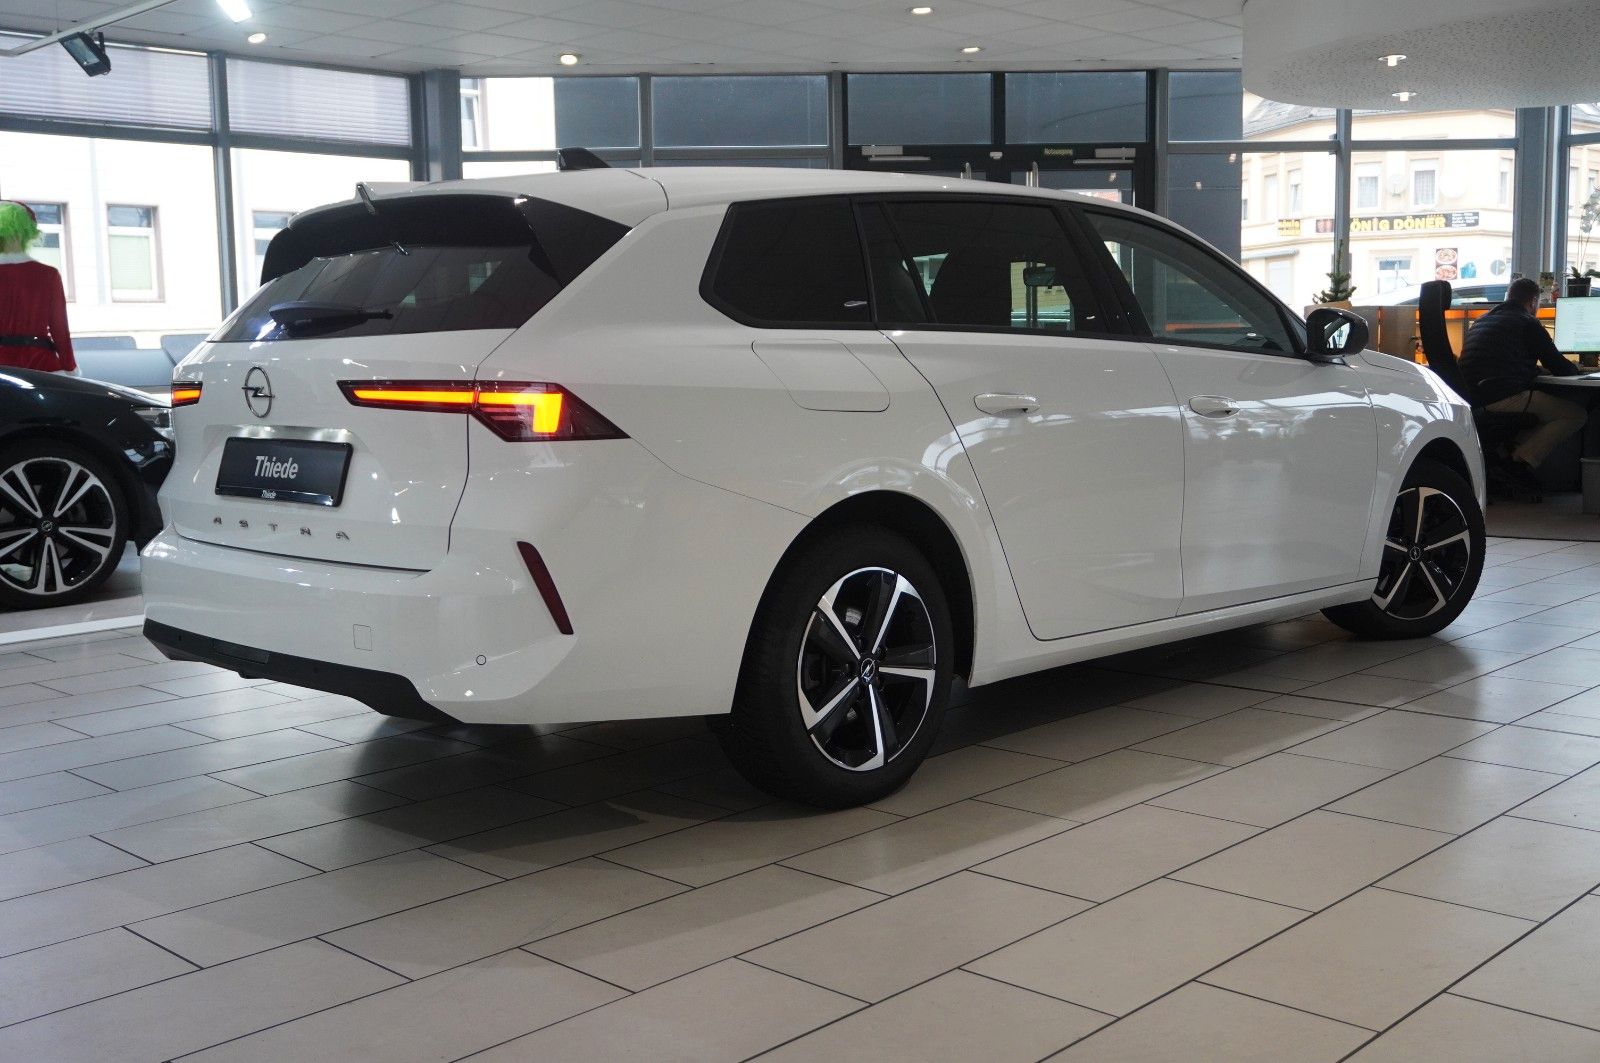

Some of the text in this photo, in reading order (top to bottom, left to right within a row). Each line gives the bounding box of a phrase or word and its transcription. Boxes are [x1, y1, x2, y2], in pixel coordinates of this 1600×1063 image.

[1393, 215, 1446, 230] DÖNER
[254, 455, 299, 479] Thiede
[261, 489, 277, 499] Thiede
[213, 516, 350, 541] ASTRA
